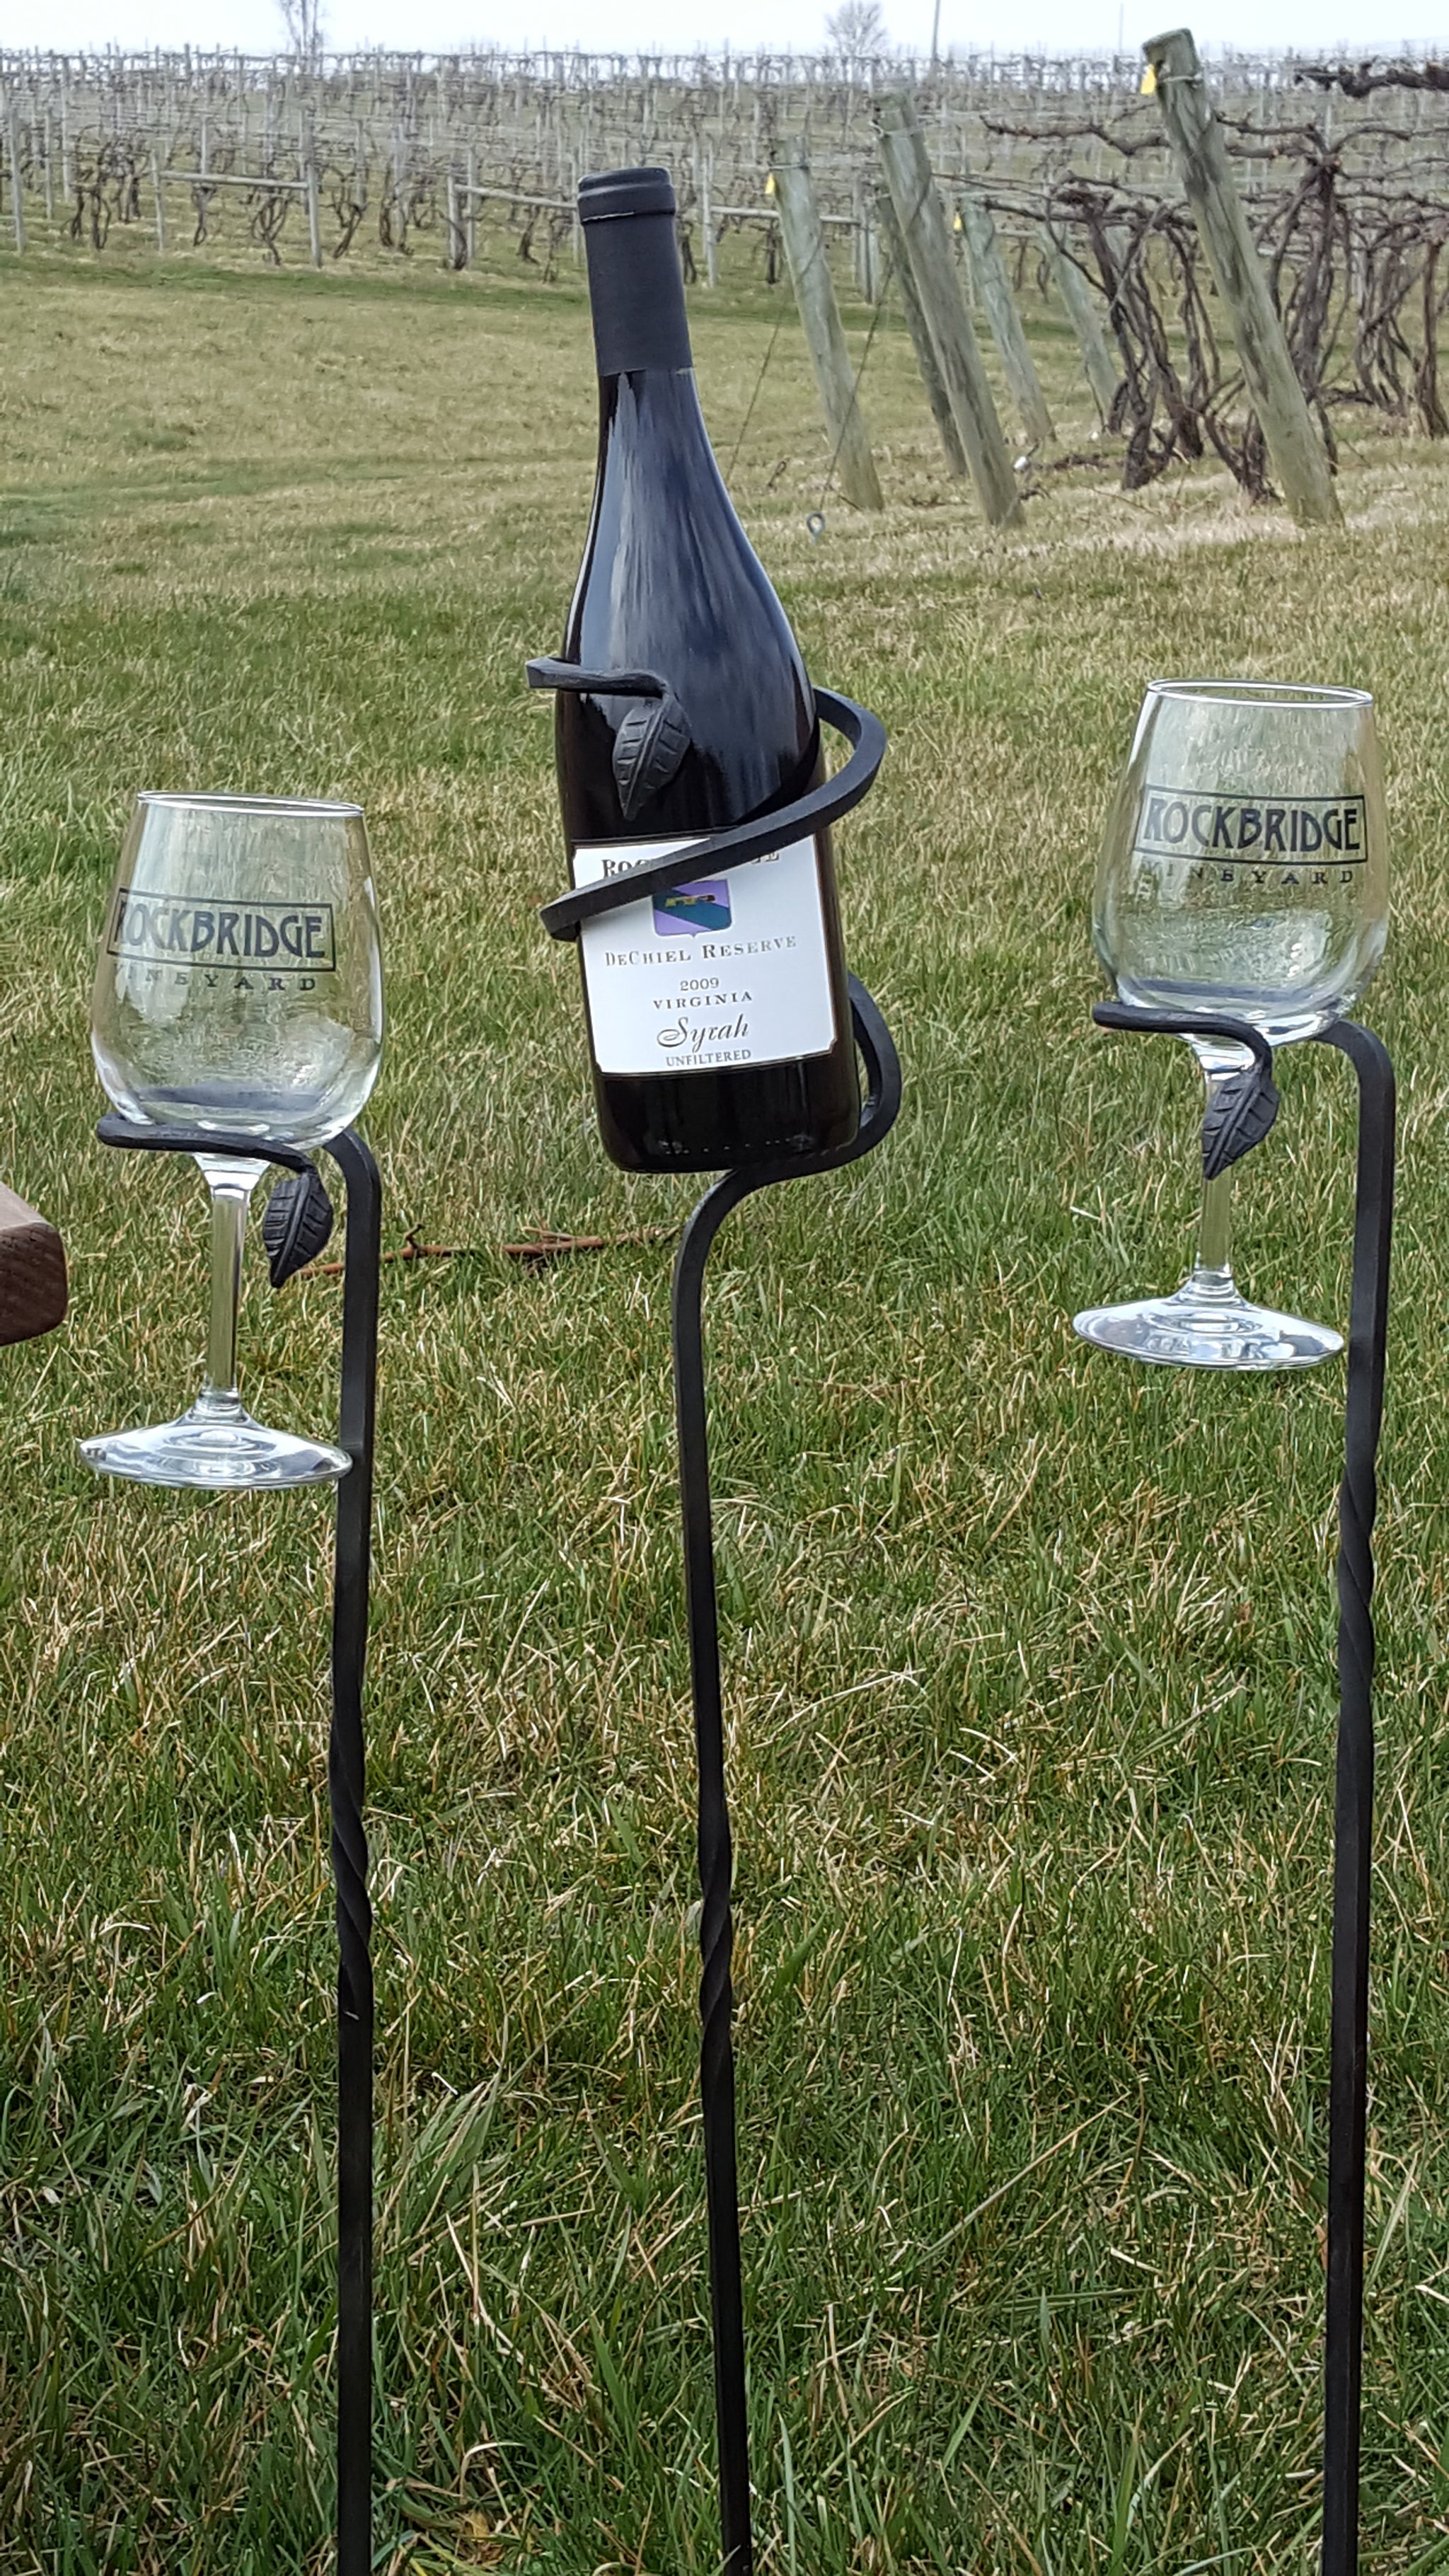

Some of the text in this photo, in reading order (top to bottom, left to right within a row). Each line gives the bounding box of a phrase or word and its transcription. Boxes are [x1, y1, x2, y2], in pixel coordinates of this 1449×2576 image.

[1143, 797, 1361, 852] ROCKBRIDGE
[1141, 859, 1353, 884] VINEYARD
[680, 977, 720, 991] 2009
[653, 991, 752, 1010] VIRGINIA
[657, 1013, 749, 1053] Syrah
[666, 1049, 751, 1066] UNFILTERED
